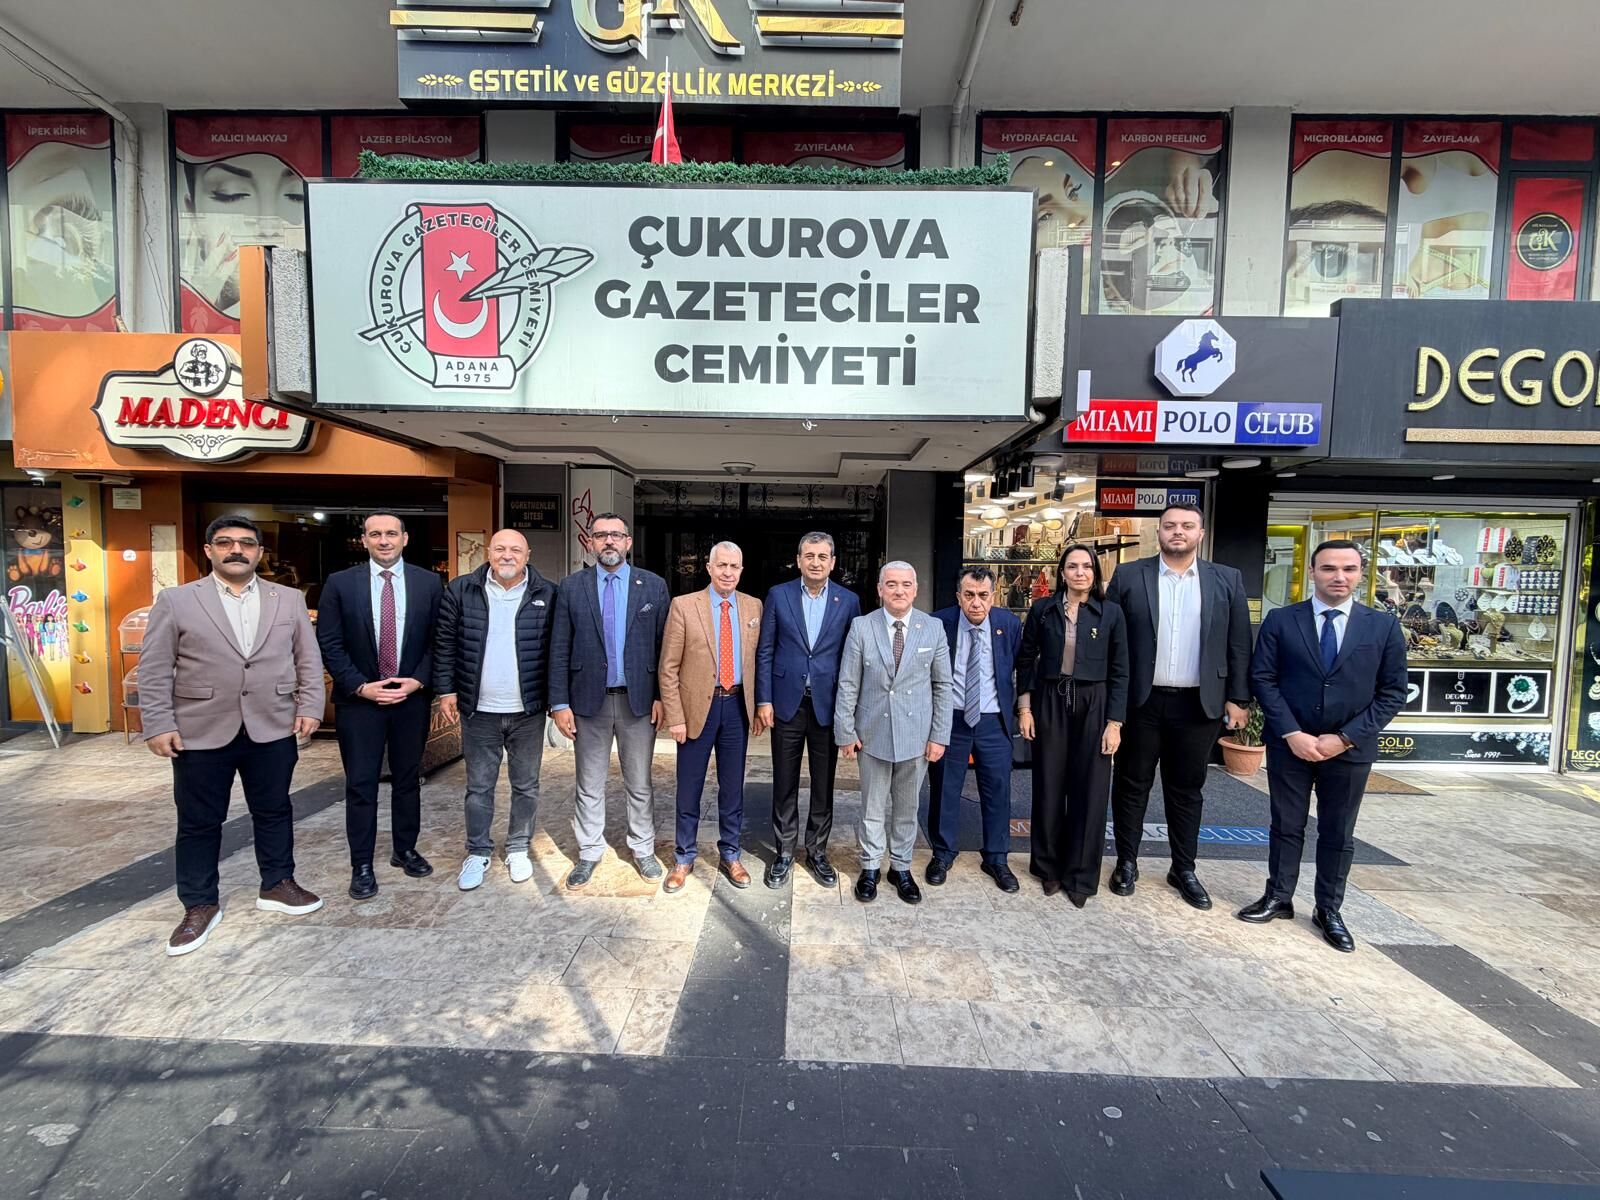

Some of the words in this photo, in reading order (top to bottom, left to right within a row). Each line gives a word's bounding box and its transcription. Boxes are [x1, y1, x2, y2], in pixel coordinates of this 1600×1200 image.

[469, 65, 568, 92] ESTETİK
[574, 75, 599, 92] ve
[606, 66, 721, 95] GÜZELLİK
[728, 69, 835, 97] MERKEZİ
[28, 125, 51, 136] İPEK
[53, 125, 87, 136] KİRPİK
[211, 134, 244, 142] KALICI
[246, 134, 288, 143] MAKYAJ
[360, 135, 392, 144] LAZER
[395, 133, 452, 144] EPİLASYON
[620, 135, 642, 144] CİLT
[1001, 134, 1078, 143] HYDRAFACIAL
[1121, 134, 1163, 143] KARBON
[1165, 134, 1207, 143] PEELING
[1303, 134, 1384, 143] MICROBLADING
[1423, 135, 1480, 144] ZAYIFLAMA
[794, 143, 855, 152] ZAYIFLAMA
[629, 216, 949, 268] ÇUKUROVA
[381, 250, 412, 354] ÇUKUROVA
[402, 213, 522, 254] GAZETECİLER
[518, 254, 544, 349] CEMİYETİ
[594, 270, 980, 324] GAZETECİLER
[654, 333, 917, 386] CEMİYETİ
[445, 361, 499, 372] ADANA
[454, 373, 491, 383] 1975
[1407, 346, 1600, 412] DEGO
[1074, 410, 1153, 433] MIAMI
[1162, 410, 1231, 433] POLO
[1244, 412, 1314, 435] CLUB
[1102, 493, 1134, 504] MIAMI
[1137, 493, 1164, 505] POLO
[1169, 494, 1197, 505] CLUB
